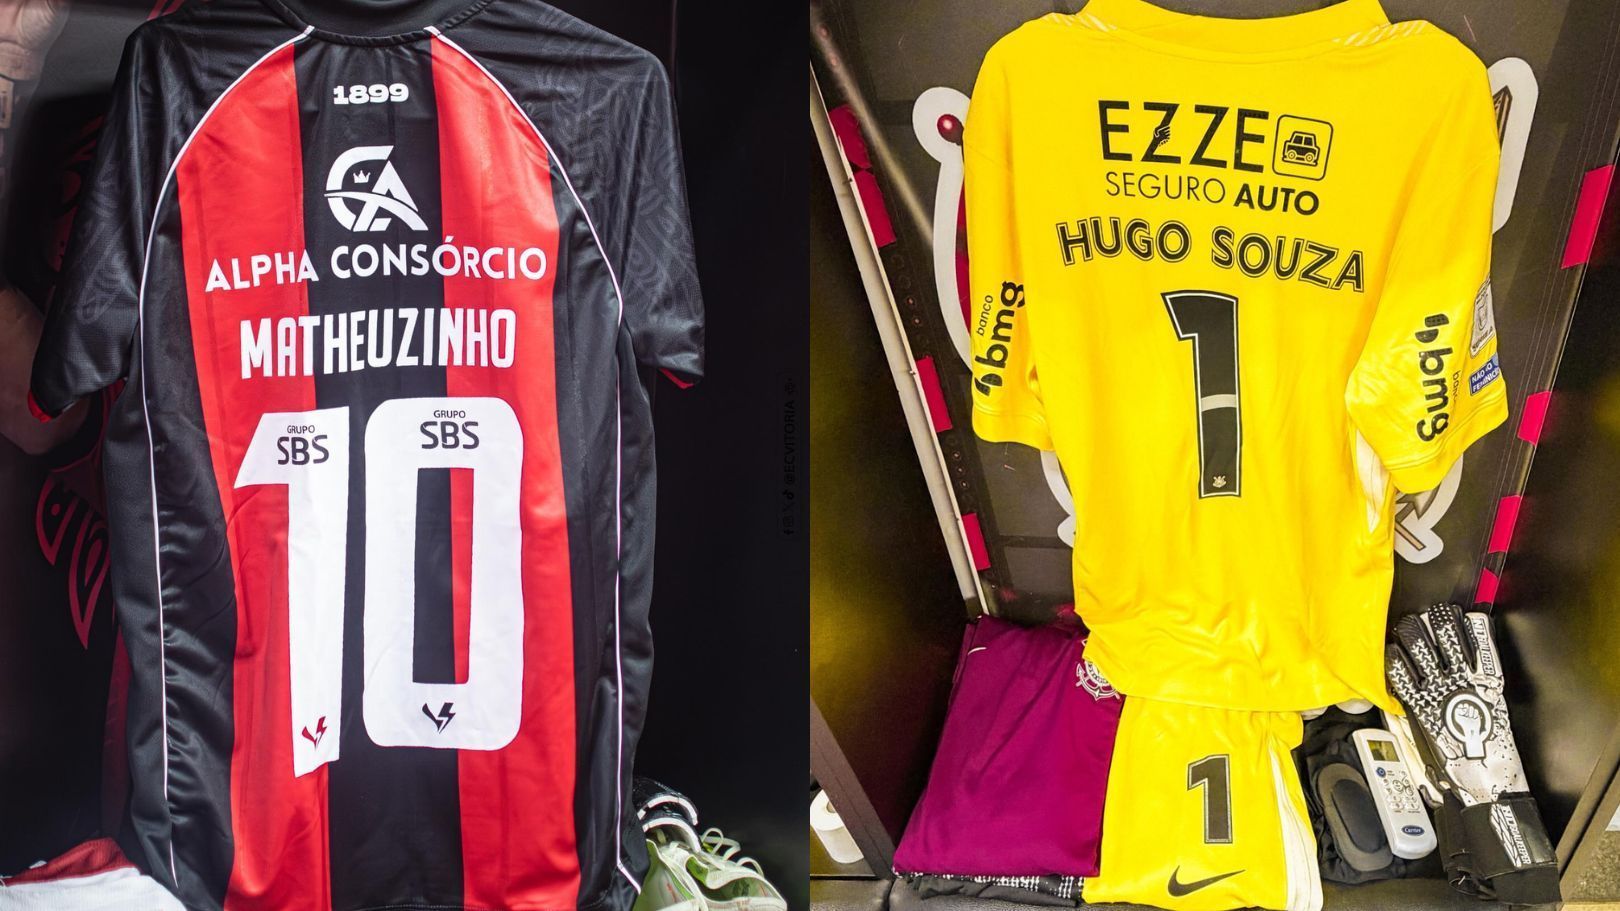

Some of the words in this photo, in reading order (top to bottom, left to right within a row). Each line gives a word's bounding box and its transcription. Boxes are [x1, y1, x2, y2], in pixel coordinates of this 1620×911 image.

[333, 83, 409, 105] 1899
[1098, 100, 1270, 174] EZZE
[1105, 171, 1226, 204] SEGURO
[1233, 182, 1320, 216] AUTO
[205, 249, 319, 293] ALPHA
[330, 235, 547, 281] CONSÓRCIO
[1056, 216, 1192, 267] HUGO
[1211, 225, 1365, 293] SOUZA
[240, 307, 517, 380] MATHEUZINHO
[974, 280, 1025, 369] bmg
[976, 294, 994, 337] banco
[433, 409, 467, 419] GRUPO
[1160, 289, 1243, 499] 1
[1417, 347, 1453, 442] bmg
[276, 434, 330, 466] SBS
[286, 424, 316, 434] GRUPO
[419, 420, 480, 450] SBS
[233, 396, 525, 778] 10
[1187, 754, 1233, 845] 1
